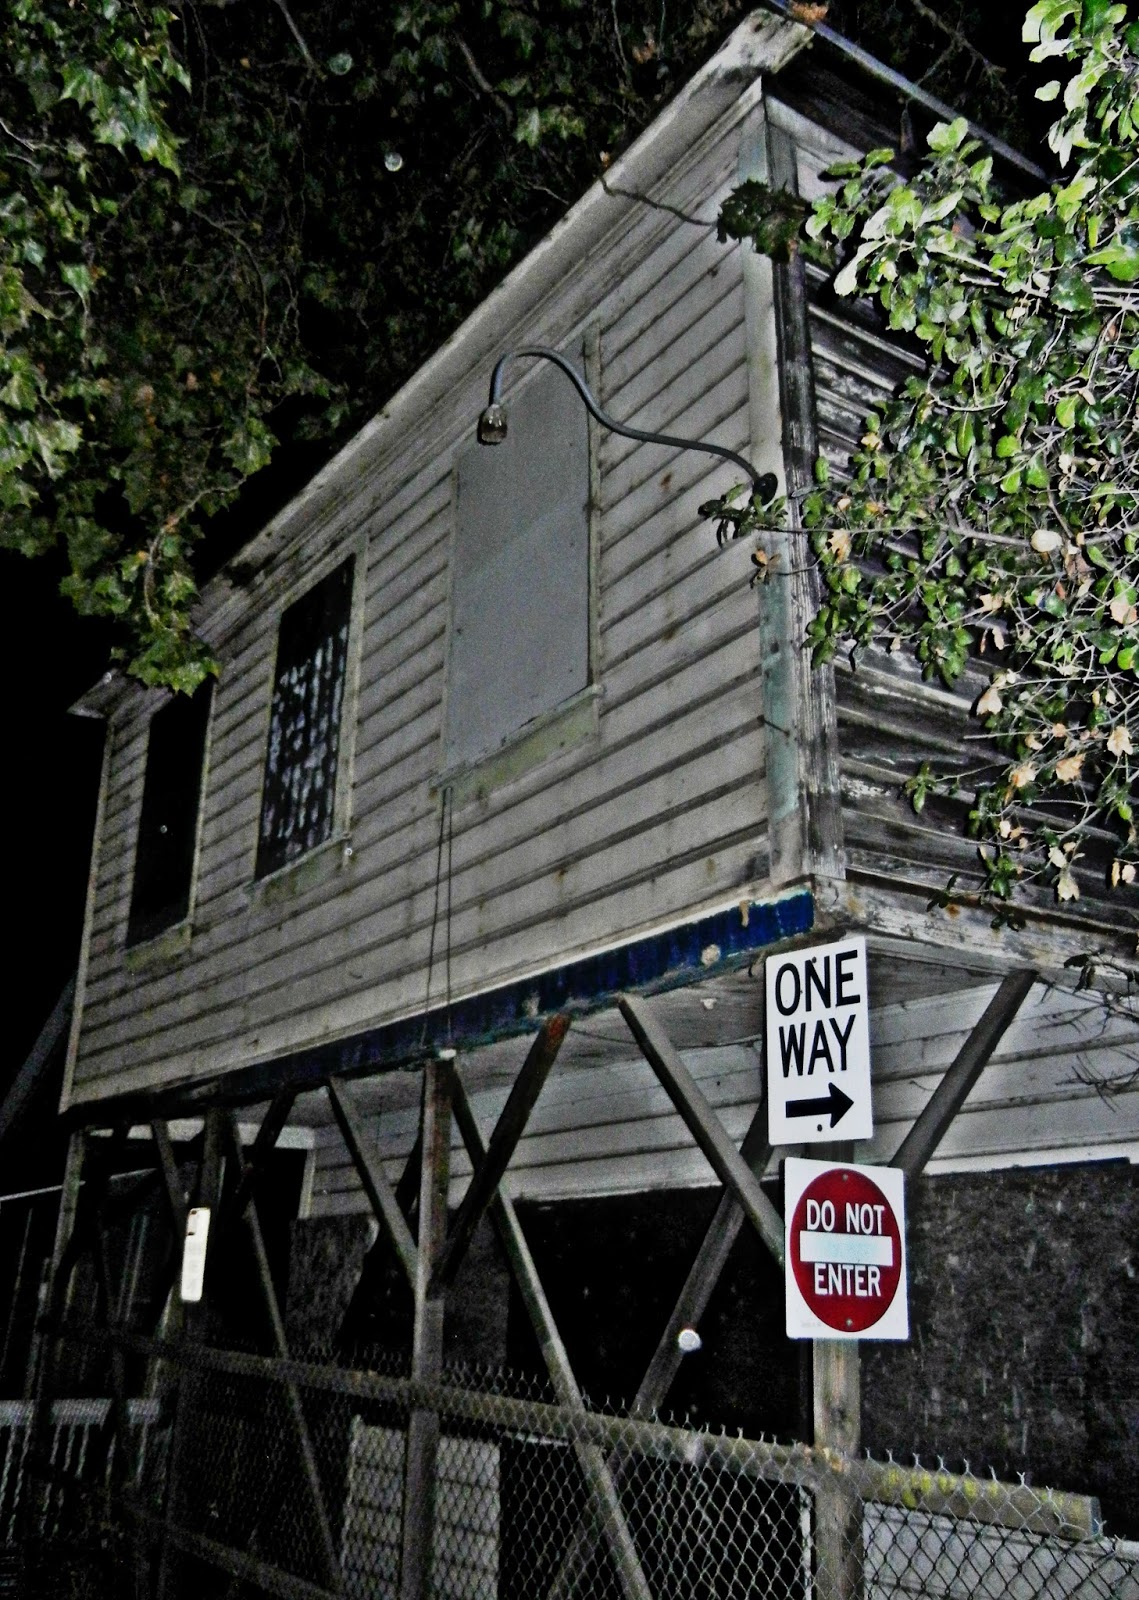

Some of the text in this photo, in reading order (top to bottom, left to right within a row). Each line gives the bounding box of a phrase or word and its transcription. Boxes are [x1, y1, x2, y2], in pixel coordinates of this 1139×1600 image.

[775, 949, 861, 1016] ONE
[779, 1014, 857, 1078] WAY
[805, 1199, 886, 1235] DO NOT
[813, 1263, 882, 1297] ENTER
